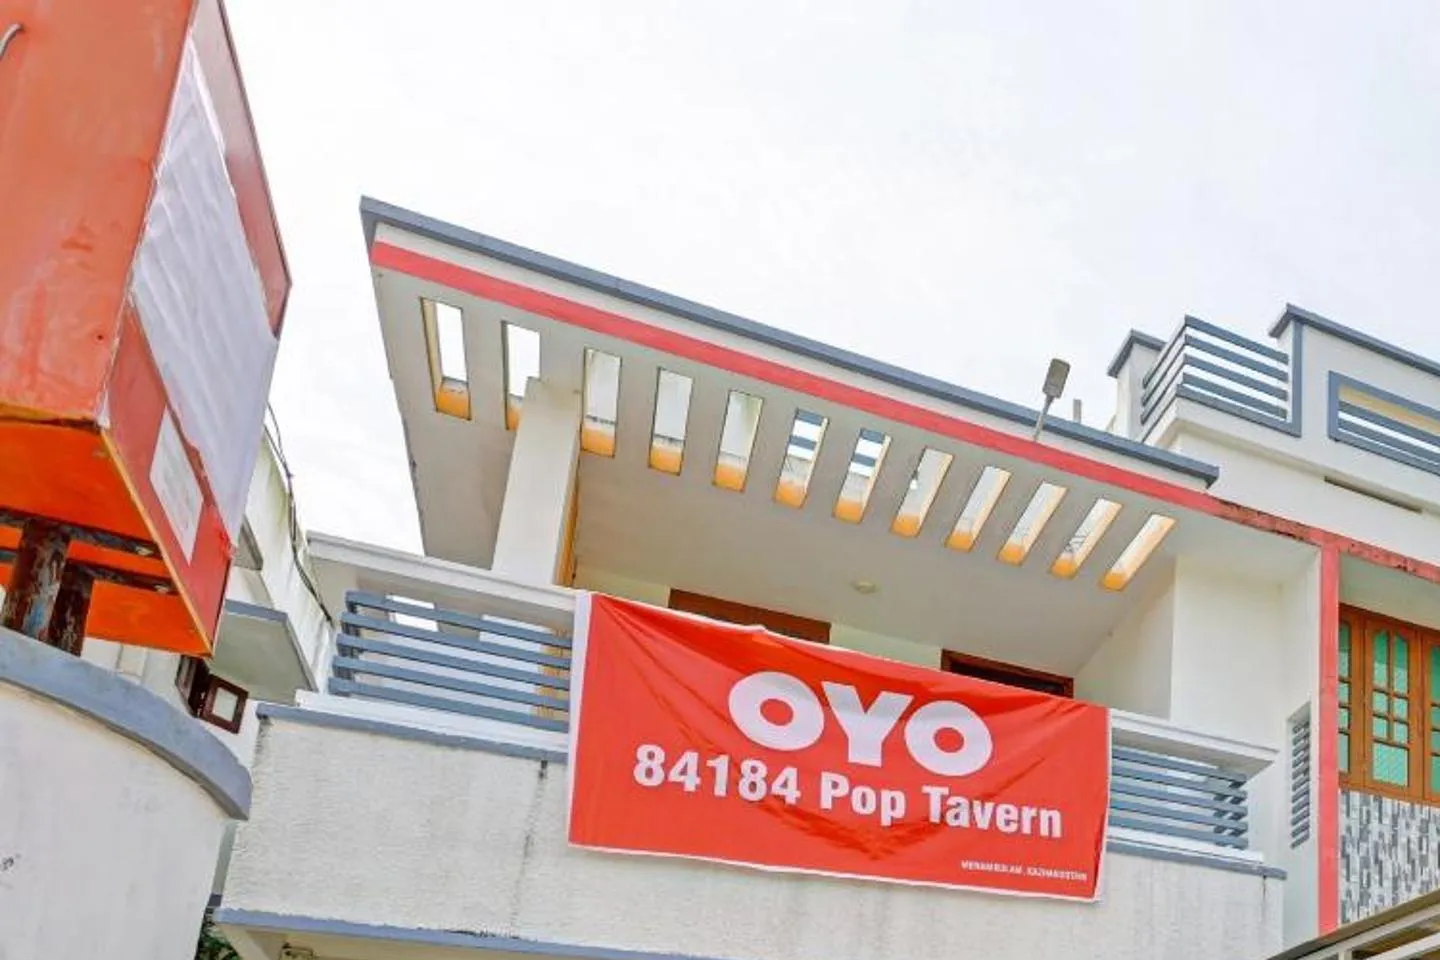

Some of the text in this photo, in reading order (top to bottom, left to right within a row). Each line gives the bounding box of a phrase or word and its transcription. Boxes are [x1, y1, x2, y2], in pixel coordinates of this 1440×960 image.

[728, 671, 993, 777] OYO
[633, 744, 1062, 838] 84184 Pop Tavern
